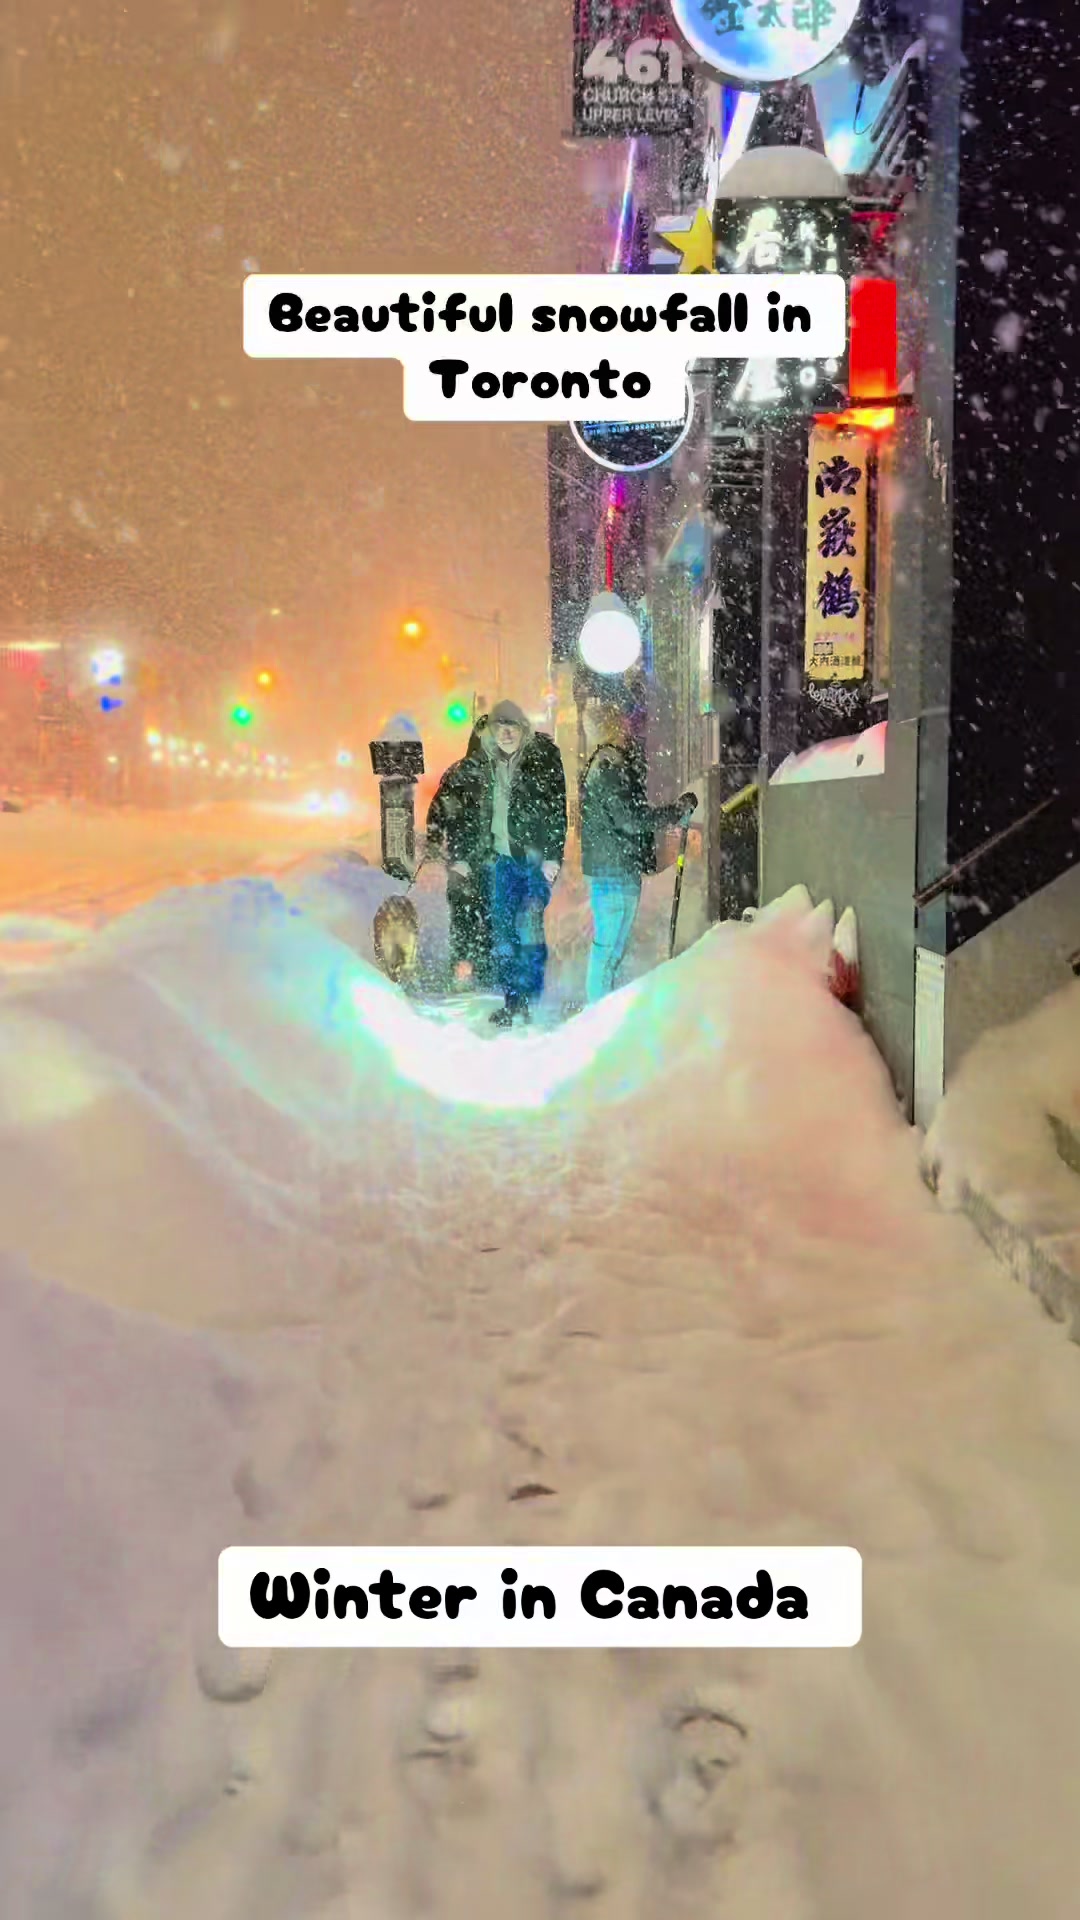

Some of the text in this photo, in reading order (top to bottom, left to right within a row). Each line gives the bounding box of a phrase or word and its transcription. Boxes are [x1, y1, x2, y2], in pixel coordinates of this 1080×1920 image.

[582, 38, 682, 84] 461
[583, 87, 655, 103] CHURCH
[583, 107, 632, 121] UPPER
